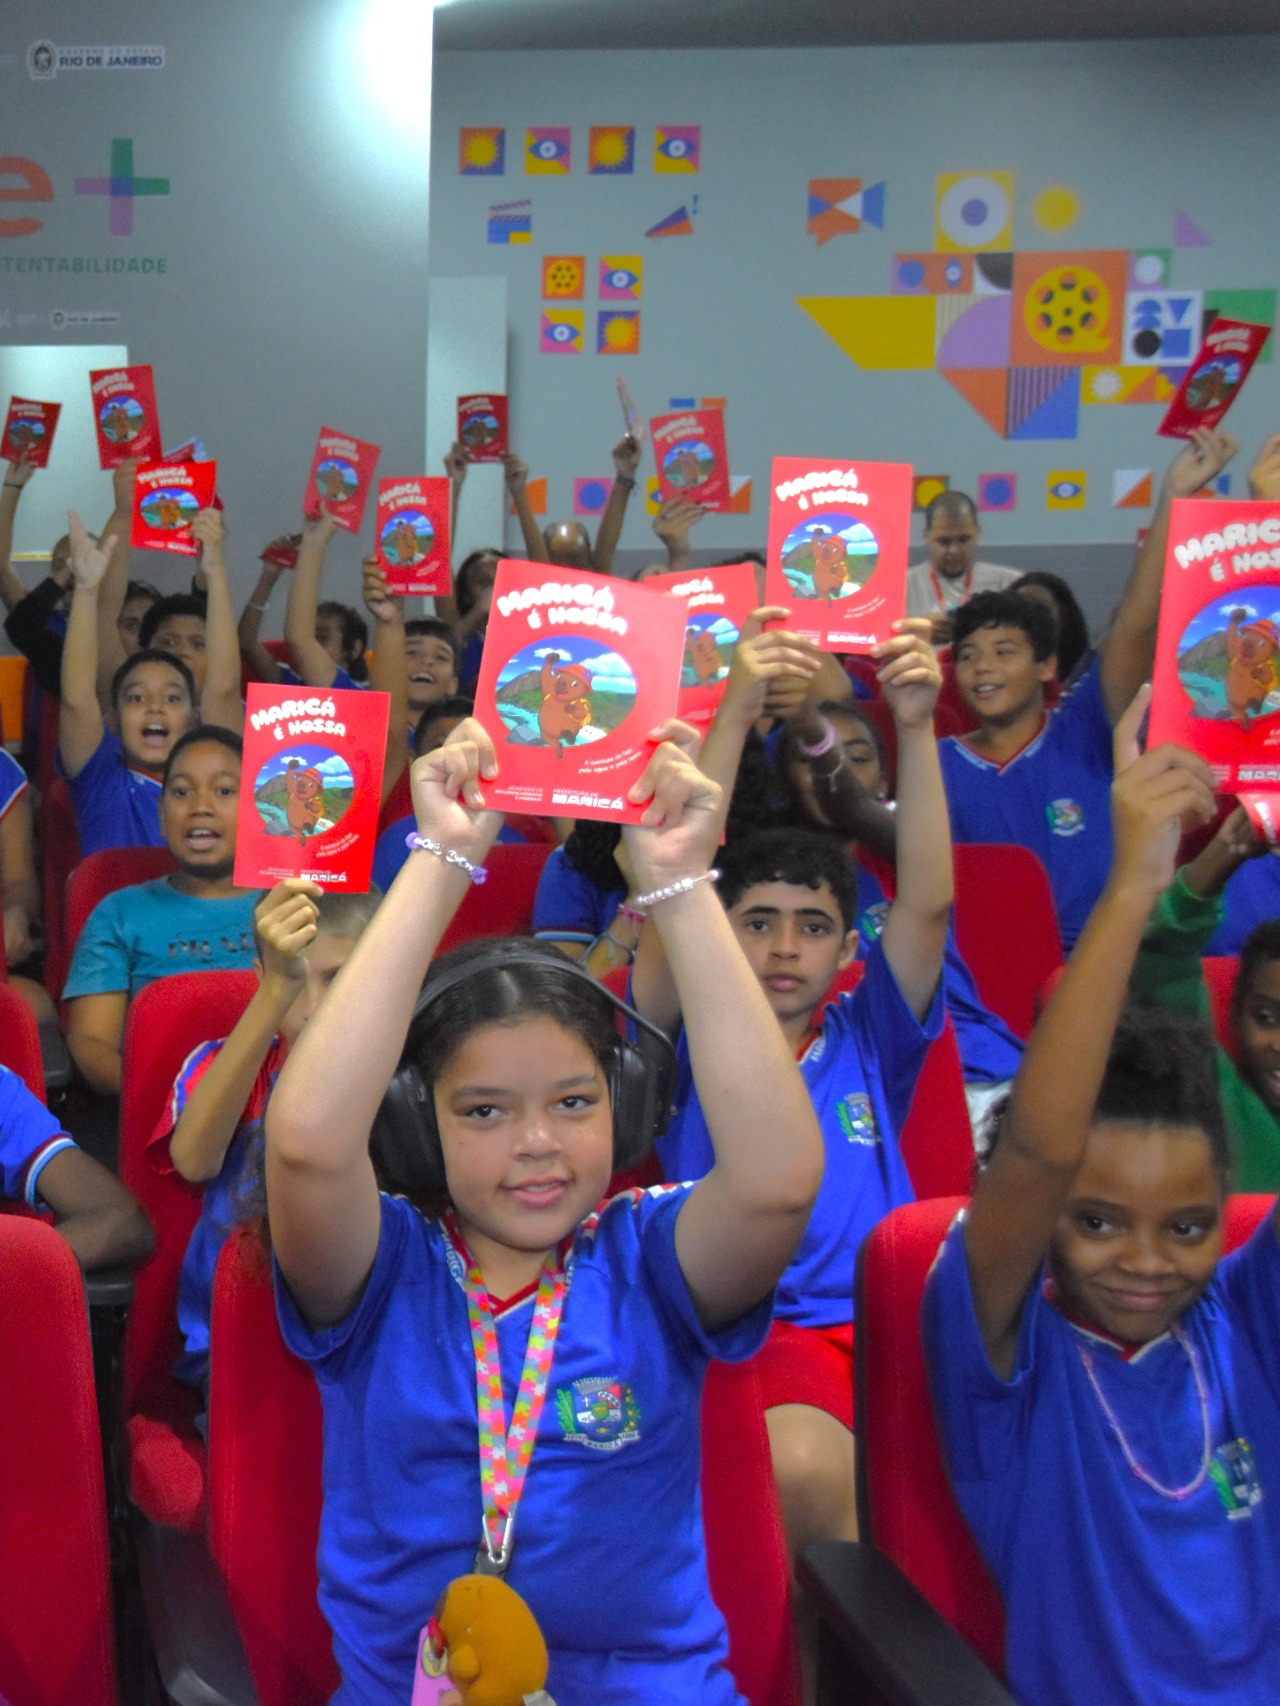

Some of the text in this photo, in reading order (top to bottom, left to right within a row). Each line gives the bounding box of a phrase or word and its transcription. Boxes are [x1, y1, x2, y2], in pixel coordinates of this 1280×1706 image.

[60, 55, 163, 67] RIO DE JANEIRO
[1174, 518, 1280, 570] MARIC
[1209, 547, 1280, 582] É NOS
[496, 583, 614, 617] MARICÁ
[547, 606, 628, 636] NOSSA
[250, 696, 336, 731] MARICÁ
[273, 718, 346, 741] É NOSSA
[552, 793, 624, 811] MARICÁ
